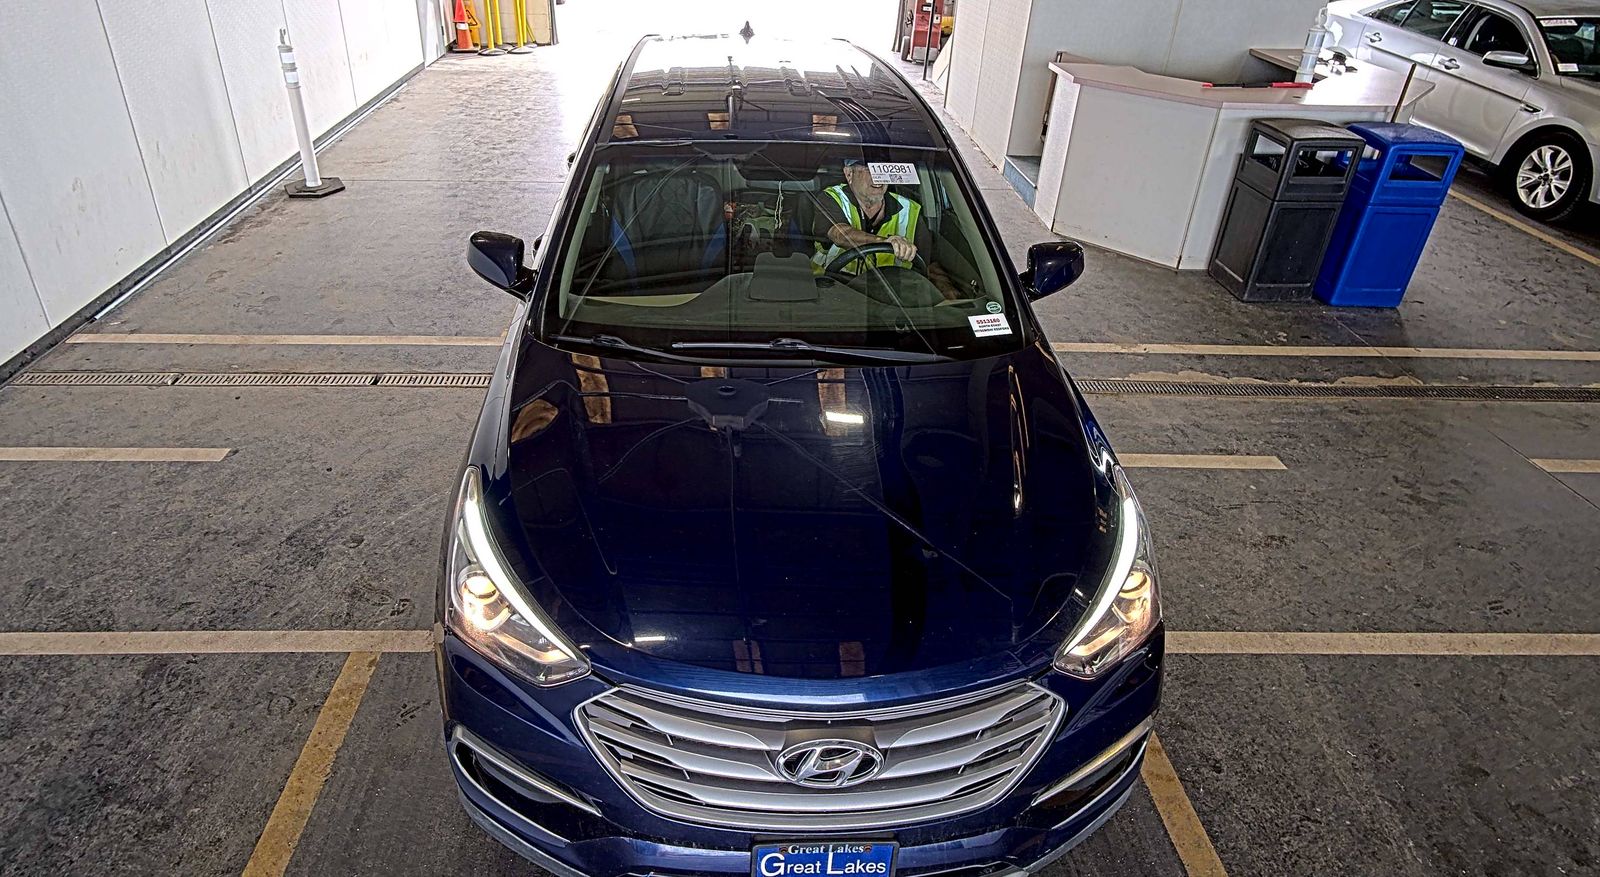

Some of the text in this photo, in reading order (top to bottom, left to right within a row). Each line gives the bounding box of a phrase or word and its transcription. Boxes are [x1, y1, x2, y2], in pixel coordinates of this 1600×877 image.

[871, 164, 912, 174] 1102981
[787, 844, 864, 855] Great Lakes
[760, 851, 887, 877] Great Lakes
